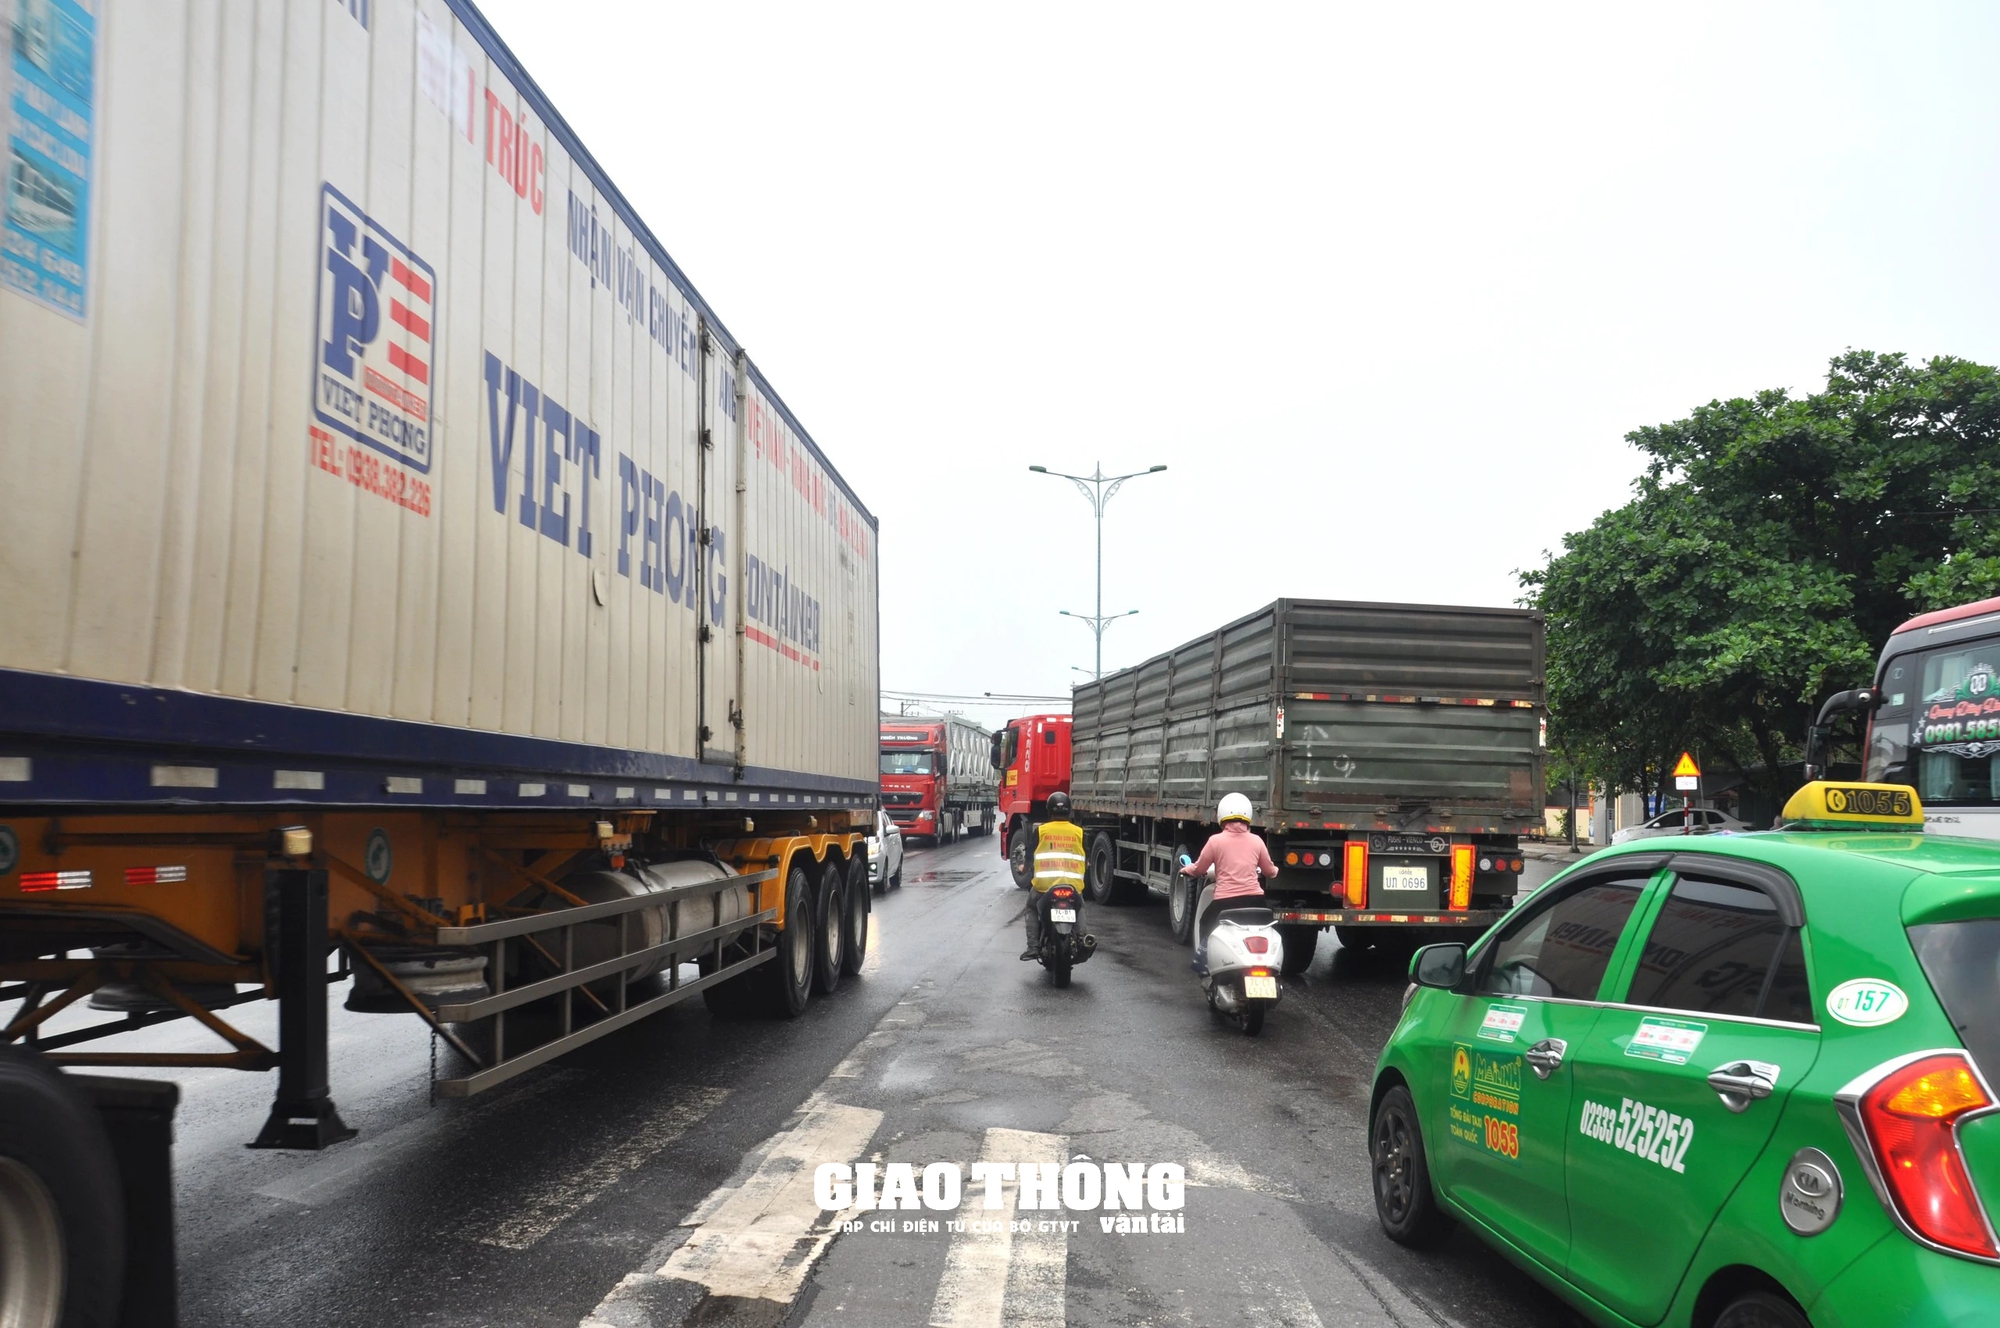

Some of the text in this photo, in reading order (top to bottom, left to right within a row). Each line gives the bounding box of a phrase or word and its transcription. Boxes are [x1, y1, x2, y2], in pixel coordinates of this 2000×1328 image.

[484, 86, 544, 216] TRÚC
[568, 189, 612, 292] NHẬN
[616, 244, 645, 327] VẬN
[322, 372, 364, 424] VIET
[367, 400, 426, 455] PHONG
[484, 349, 601, 560] VIET
[1845, 790, 1910, 815] 1055
[1402, 877, 1426, 889] 0696
[1854, 989, 1891, 1013] 157
[1473, 1091, 1519, 1116] CORPORATION
[1484, 1114, 1519, 1160] 1055
[1580, 1097, 1694, 1174] 02333 525252
[1798, 1169, 1819, 1191] KIA
[1785, 1190, 1826, 1221] Morning
